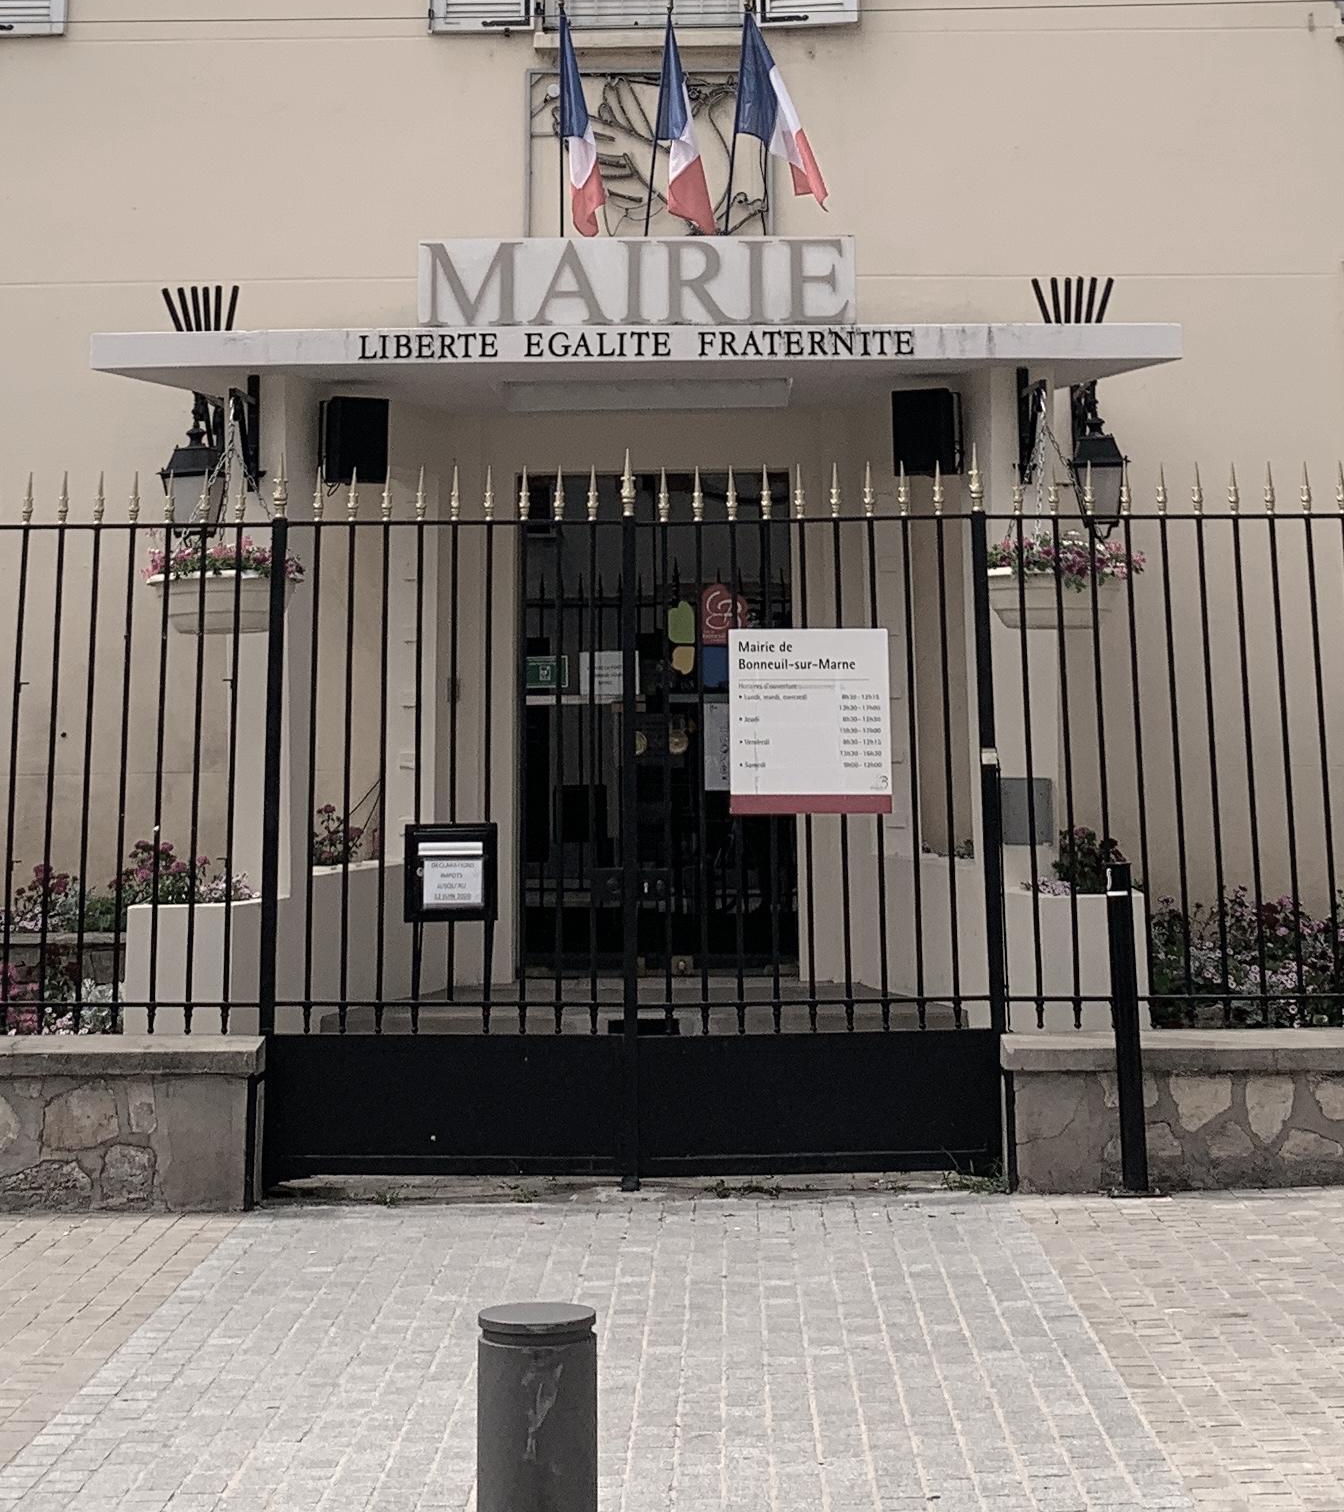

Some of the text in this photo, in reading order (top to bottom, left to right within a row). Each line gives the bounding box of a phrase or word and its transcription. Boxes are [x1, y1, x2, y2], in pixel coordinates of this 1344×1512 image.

[420, 239, 850, 327] MAIRIE
[358, 330, 915, 360] LIBERTE EGALITE FRATERNITE
[738, 641, 793, 653] Mairie de
[738, 658, 856, 671] Bonneuil-sur-Marne
